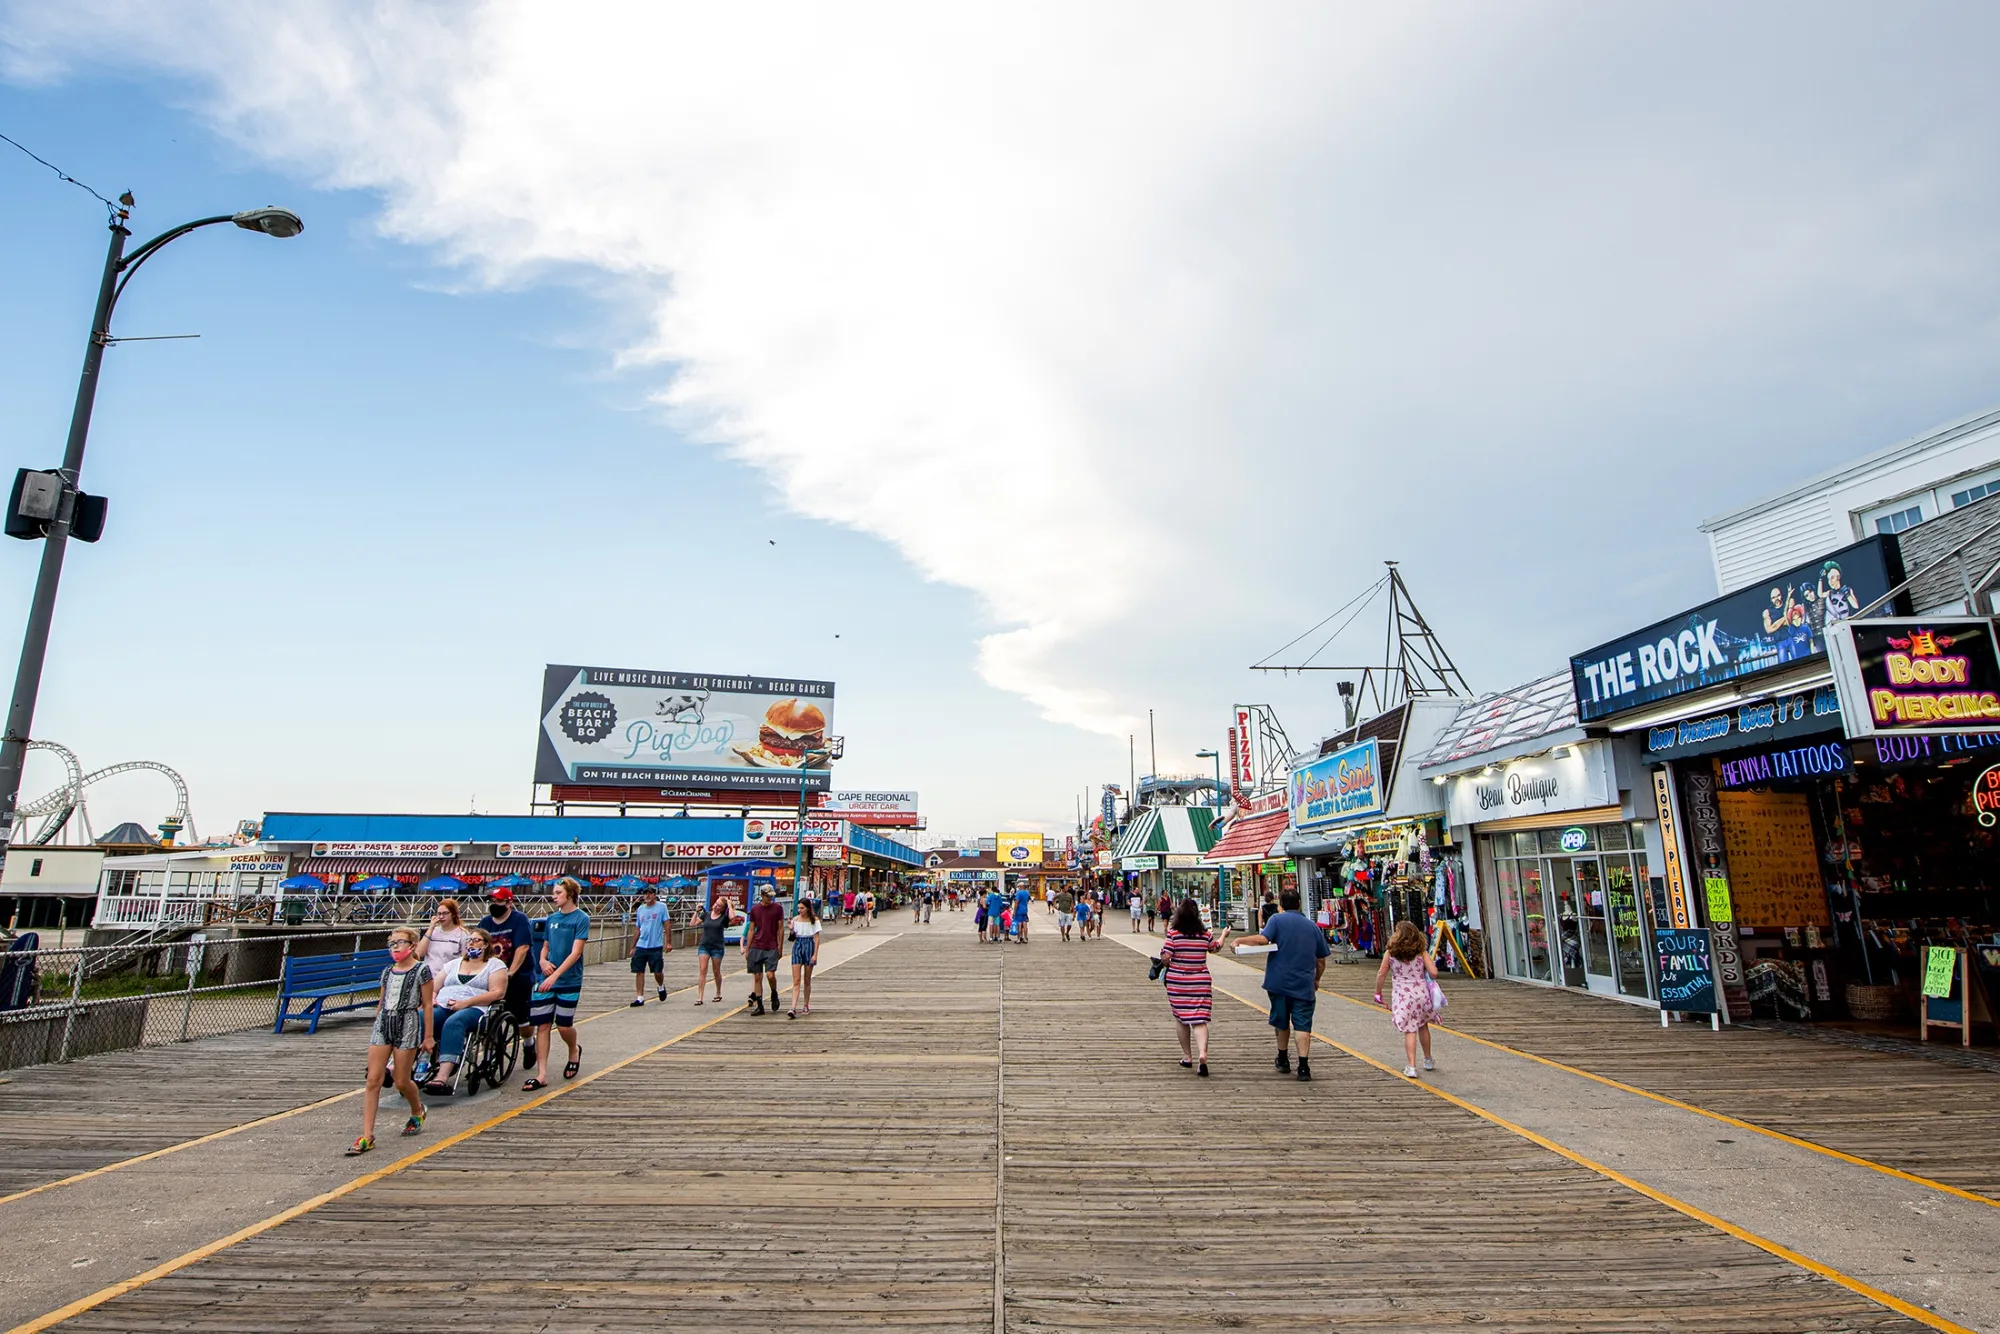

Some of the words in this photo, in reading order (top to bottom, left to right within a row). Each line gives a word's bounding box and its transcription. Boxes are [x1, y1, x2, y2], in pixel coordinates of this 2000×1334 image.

[1584, 651, 1636, 703] THE
[1638, 618, 1725, 688] ROCK
[1887, 653, 1966, 685] BODY
[593, 671, 614, 682] LIVE
[618, 672, 647, 684] MUSIC
[650, 675, 677, 685] DAILY
[693, 677, 708, 687] KID
[711, 678, 753, 690] FRIENDLY
[768, 681, 796, 692] BEACH
[798, 684, 826, 694] GAMES
[567, 708, 611, 719] BEACH
[1871, 690, 2000, 721] PIERCING
[576, 718, 602, 728] BAR
[1649, 727, 1676, 752] BODY
[1678, 714, 1730, 746] PIERCING
[1738, 703, 1774, 733] ROCK
[577, 727, 597, 737] BQ
[1237, 712, 1254, 782] PIZZA
[1721, 755, 1772, 788] HENNA
[1772, 742, 1844, 778] TATTOOS
[601, 771, 618, 779] THE
[621, 772, 651, 780] BEACH
[654, 773, 689, 781] BEHIND
[692, 774, 728, 782] RAGING
[1305, 770, 1329, 805] Sun
[1328, 774, 1338, 799] n
[1338, 748, 1376, 796] Sand
[837, 793, 862, 801] CAPE
[865, 793, 911, 802] REGIONAL
[1476, 785, 1505, 811] Beau
[1507, 773, 1559, 808] Boutique
[848, 802, 878, 810] URGENT
[1341, 791, 1374, 812] CLOTHING
[1692, 775, 1721, 853] VINYL
[770, 821, 798, 831] HOT
[803, 821, 839, 831] SPOT
[1561, 834, 1584, 849] OPEN
[230, 855, 261, 863] OCEAN
[264, 855, 286, 863] VIEW
[677, 845, 704, 856] HOT
[707, 845, 741, 857] SPOT
[1657, 778, 1671, 835] BODY
[1668, 850, 1686, 926] PIERC
[230, 863, 256, 871] PATIO
[259, 863, 283, 871] OPEN
[951, 871, 972, 879] KOHR
[1702, 869, 1739, 983] RORDS
[1664, 935, 1698, 951] OUR
[1659, 954, 1710, 971] FAMILY
[1660, 971, 1677, 983] is
[1661, 974, 1713, 999] ESSENTIAL
